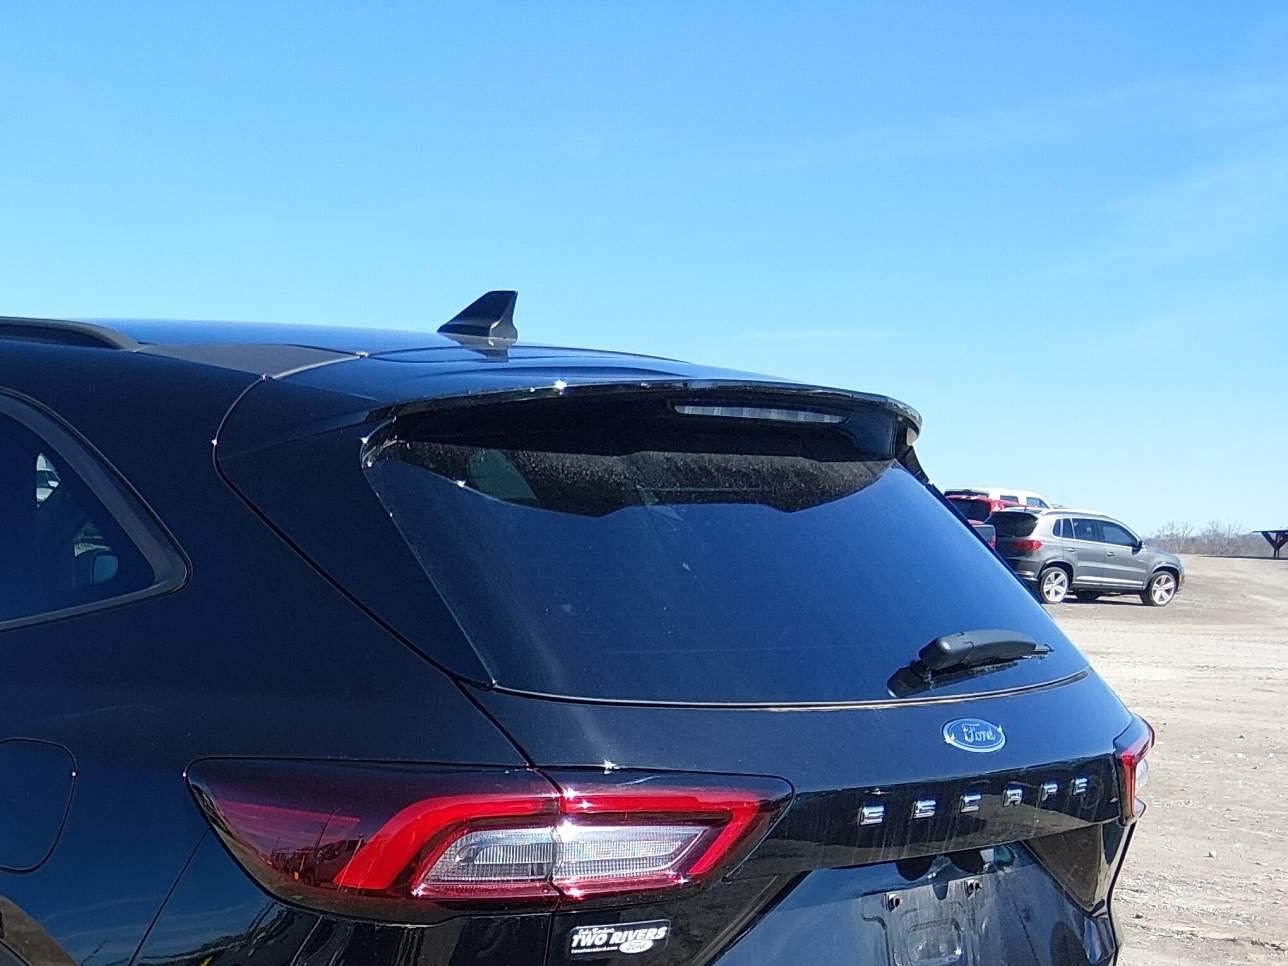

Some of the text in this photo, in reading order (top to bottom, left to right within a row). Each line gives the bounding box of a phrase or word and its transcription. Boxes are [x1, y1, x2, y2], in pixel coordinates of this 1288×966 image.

[858, 777, 1089, 826] ESCAPE
[571, 933, 609, 948] TWO
[609, 926, 668, 945] RIVERS
